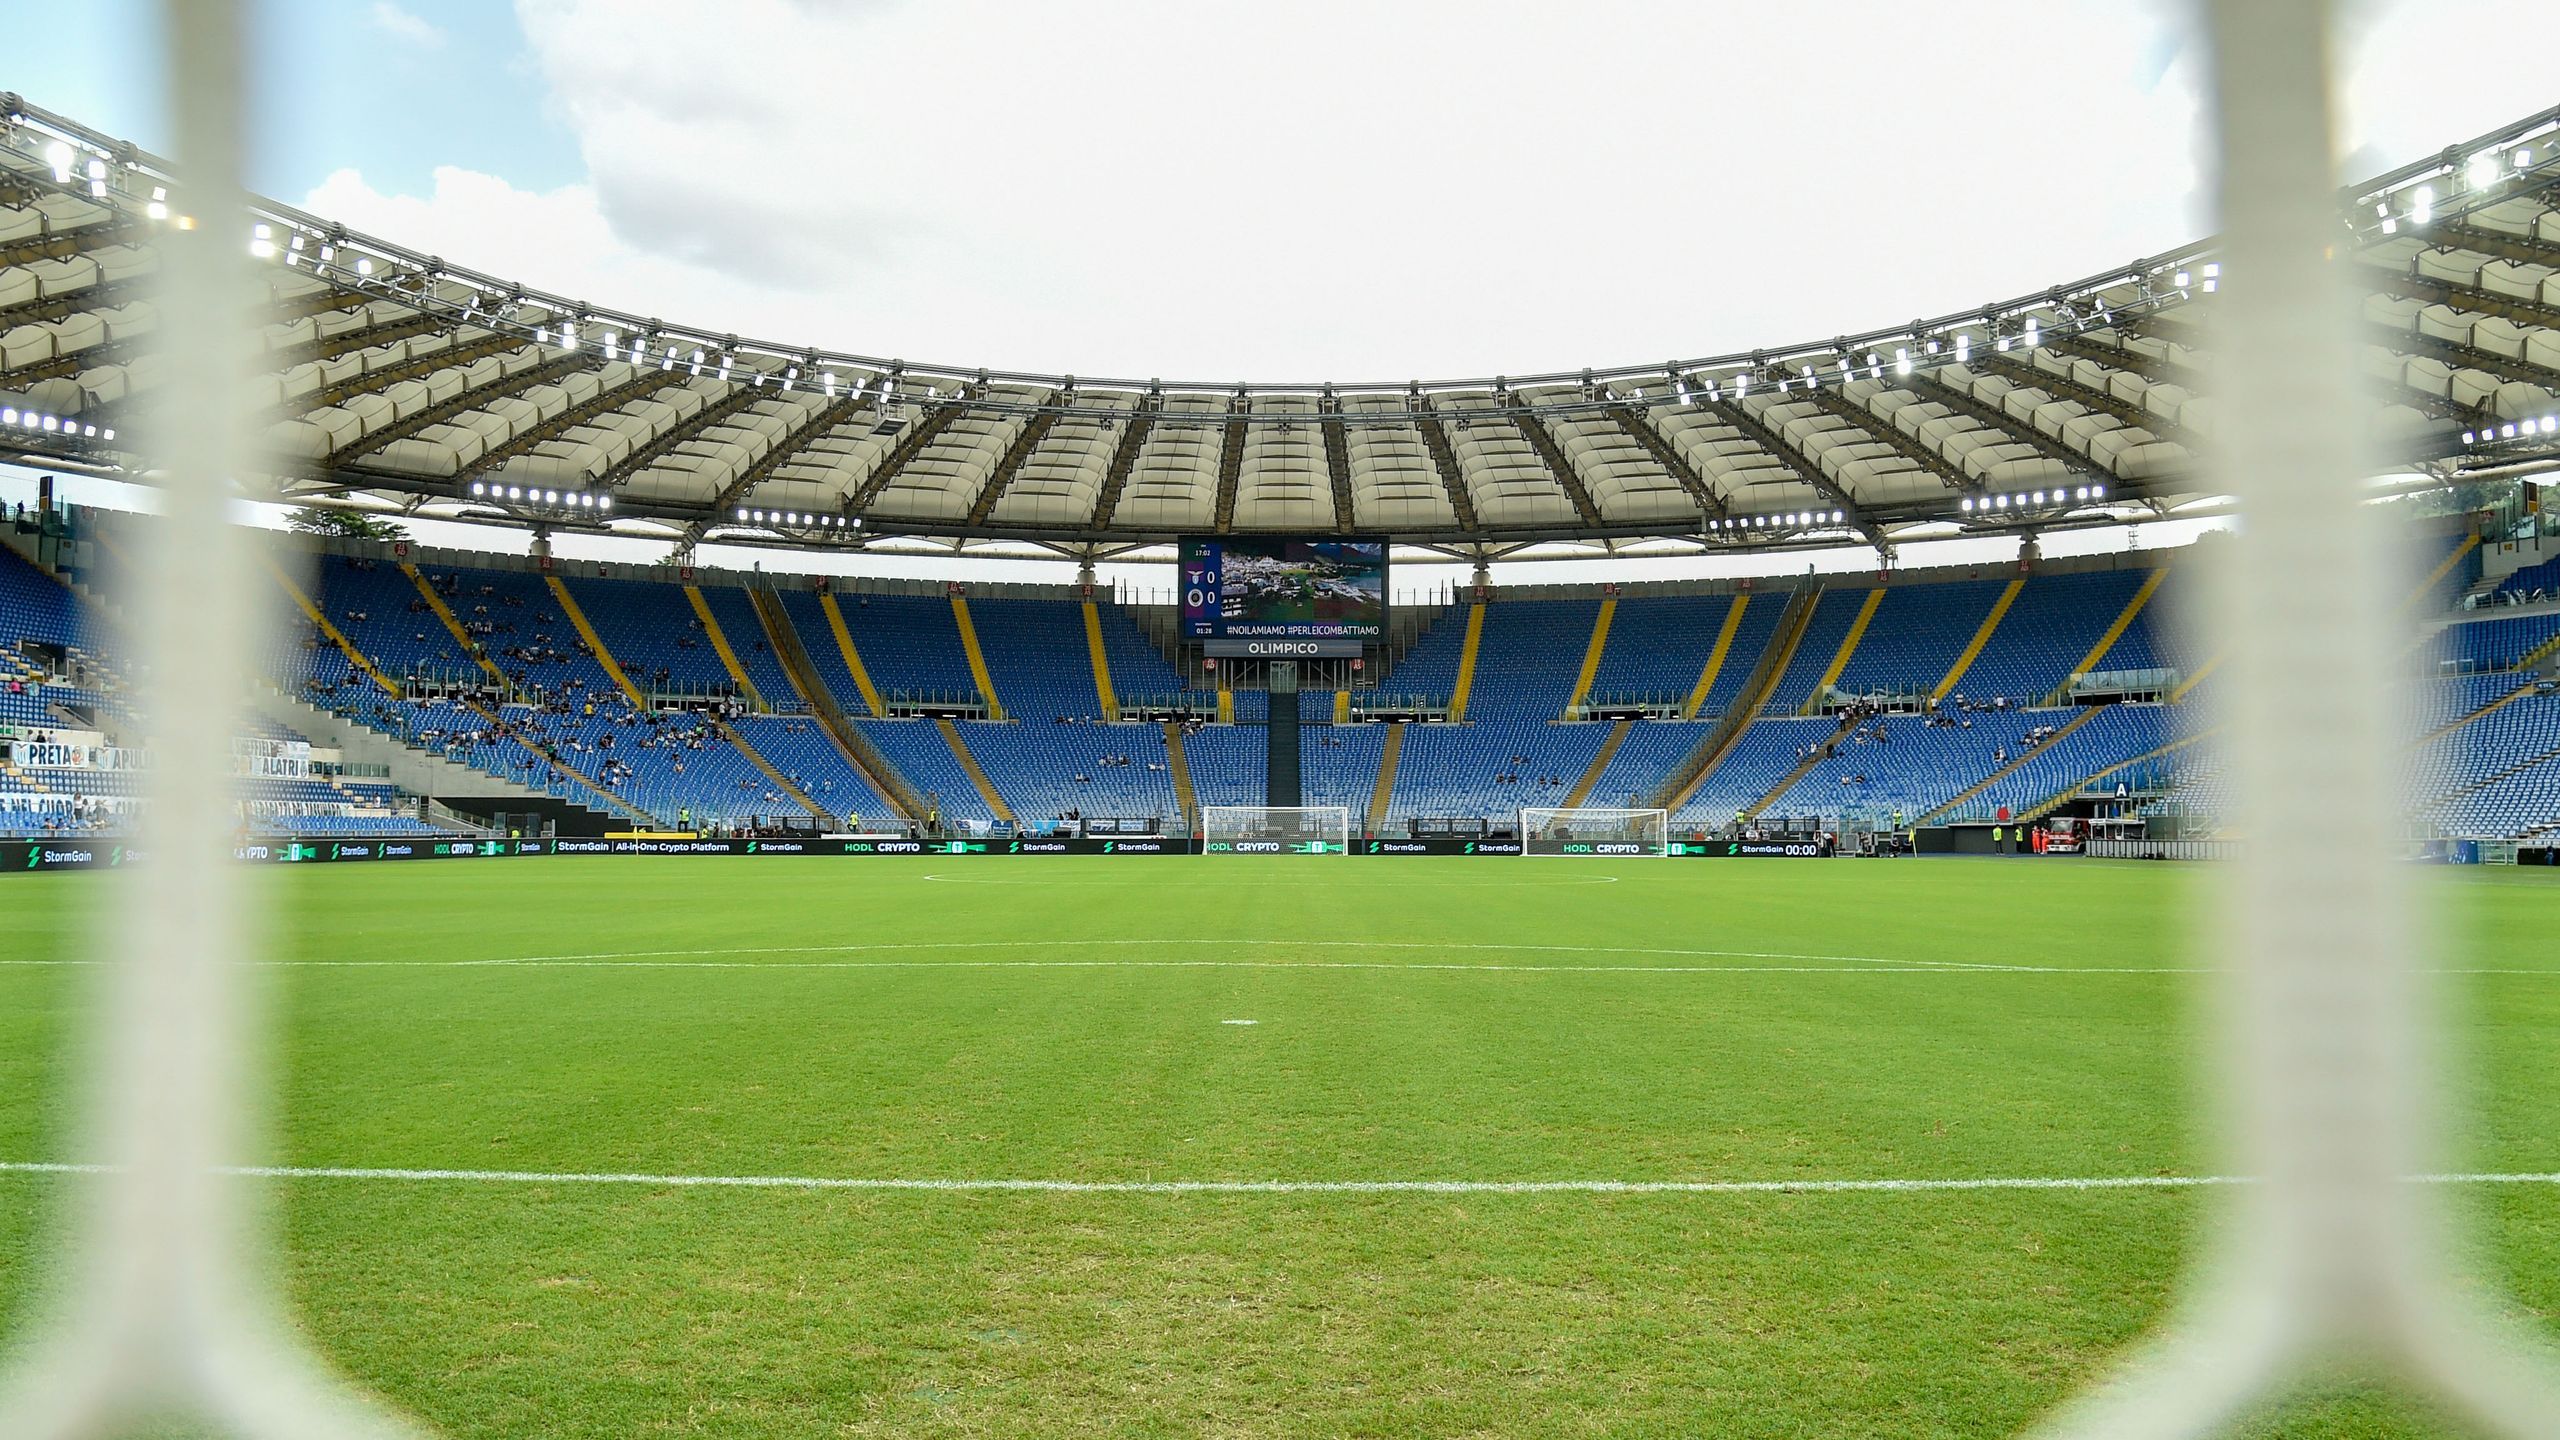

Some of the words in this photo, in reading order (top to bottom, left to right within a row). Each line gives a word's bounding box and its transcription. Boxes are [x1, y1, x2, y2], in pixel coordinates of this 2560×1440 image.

[1207, 571, 1215, 583] 0
[1207, 591, 1215, 604] 0
[1227, 626, 1285, 635] #NOILAMIAMO
[1288, 626, 1379, 635] #PERLEICOMBATTIAMO
[1249, 643, 1318, 654] OLIMPICO
[29, 744, 72, 765] PRETA
[262, 758, 299, 776] ALATRI
[2116, 783, 2127, 797] A
[341, 846, 369, 856] StormGain
[386, 846, 412, 855] StormGain
[451, 843, 474, 854] CRYPTO
[558, 842, 609, 851] StormGain
[616, 842, 658, 851] All-in-One
[659, 842, 689, 853] Crypto
[690, 842, 730, 851] Platform
[760, 843, 803, 851] StormGain
[845, 843, 874, 852] HODL
[877, 843, 920, 852] CRYPTO
[1023, 843, 1066, 851] StormGain
[1117, 843, 1160, 851] StormGain
[1236, 843, 1280, 852] CRYPTO
[1383, 843, 1426, 851] StormGain
[1478, 844, 1521, 852] StormGain
[1563, 844, 1593, 853] HODL
[1596, 844, 1640, 853] CRYPTO
[1742, 845, 1784, 853] StormGain
[1785, 845, 1817, 855] 00:00
[44, 851, 92, 863] StormGain
